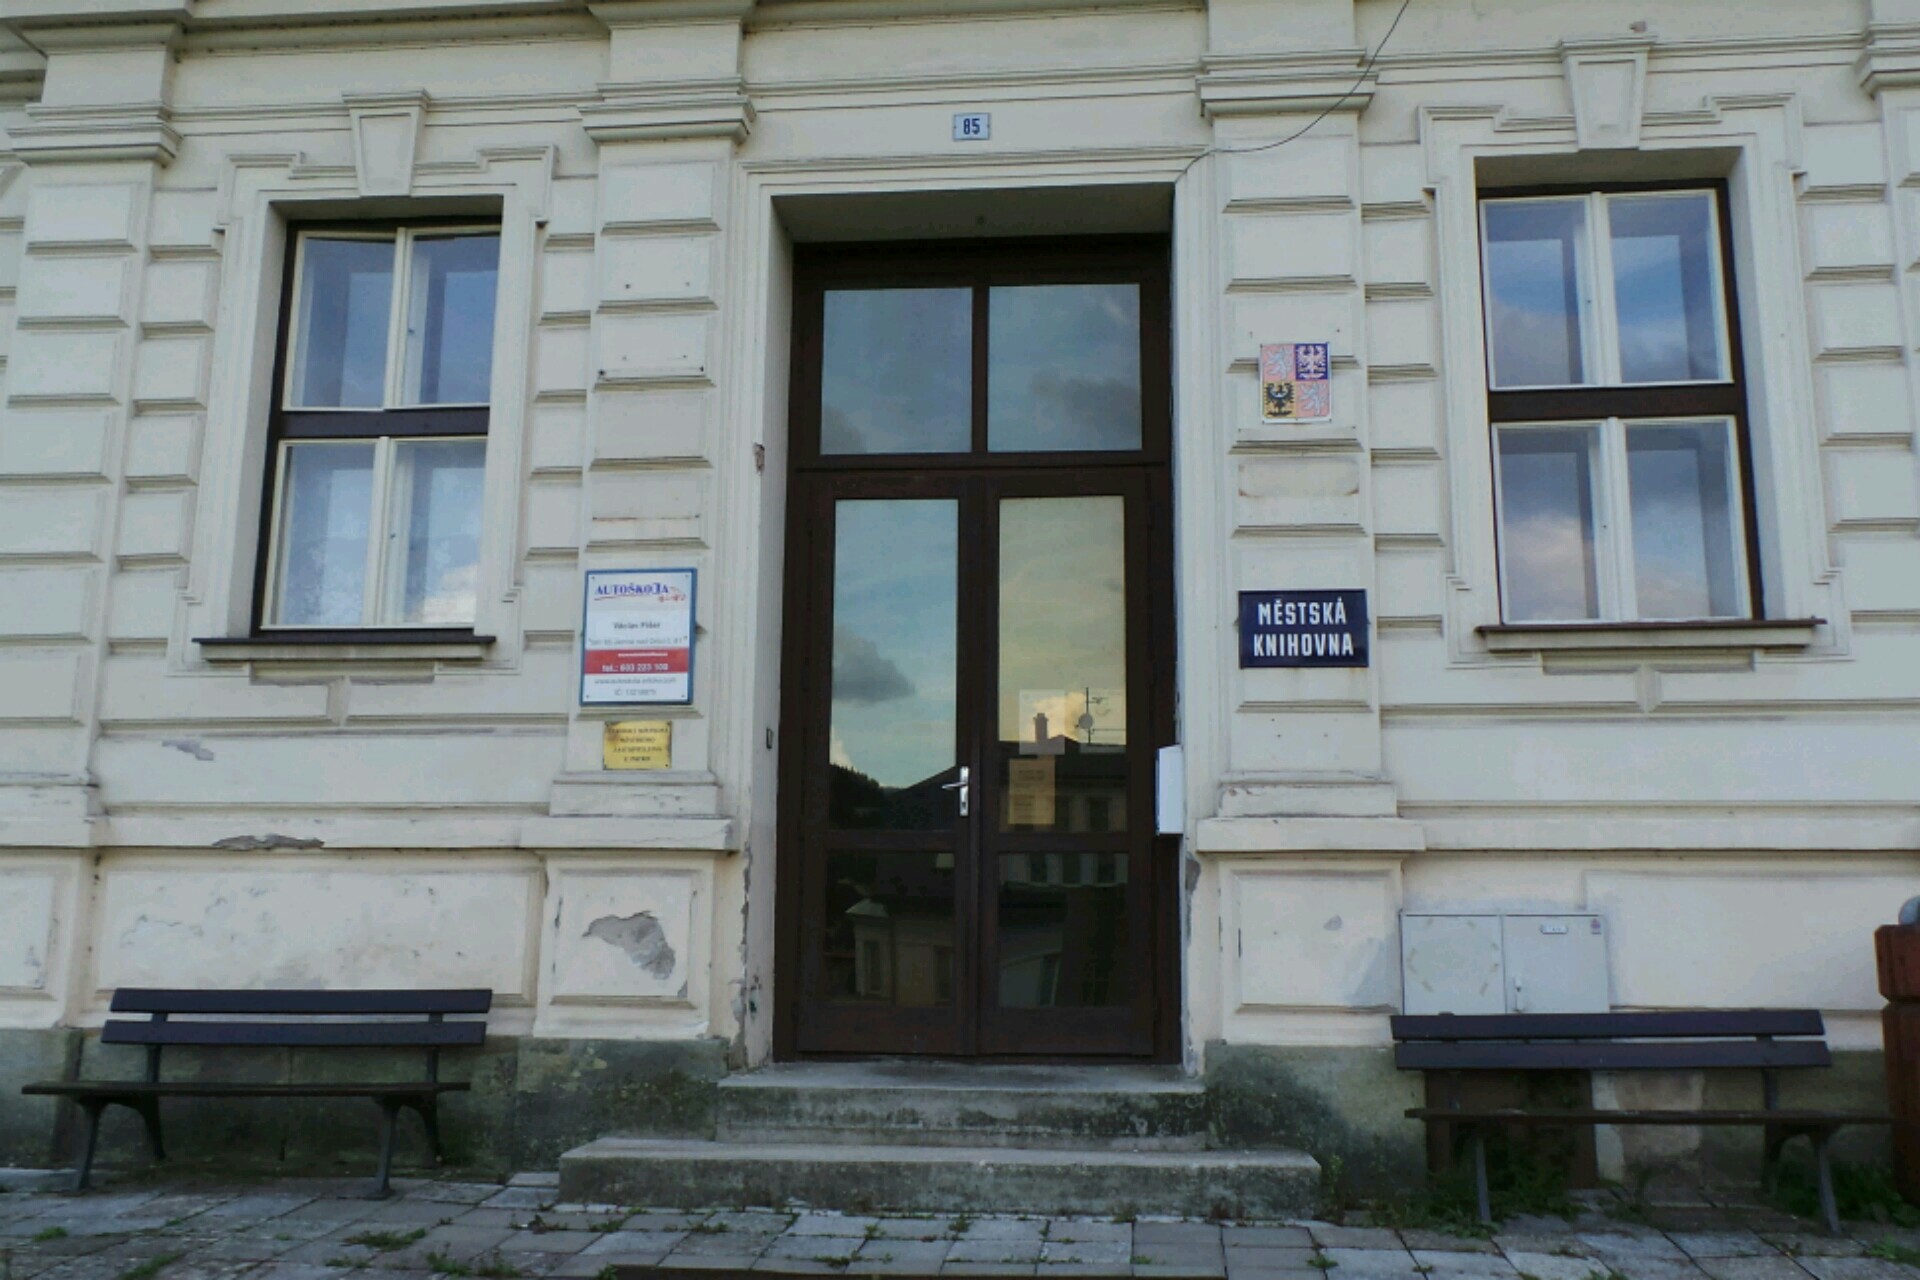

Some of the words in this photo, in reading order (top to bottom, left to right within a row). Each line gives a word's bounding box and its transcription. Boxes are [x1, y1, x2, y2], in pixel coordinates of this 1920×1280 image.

[963, 118, 981, 135] 85
[1258, 597, 1346, 625] MĚSTSKÁ
[1253, 633, 1354, 656] KNIHOVNA
